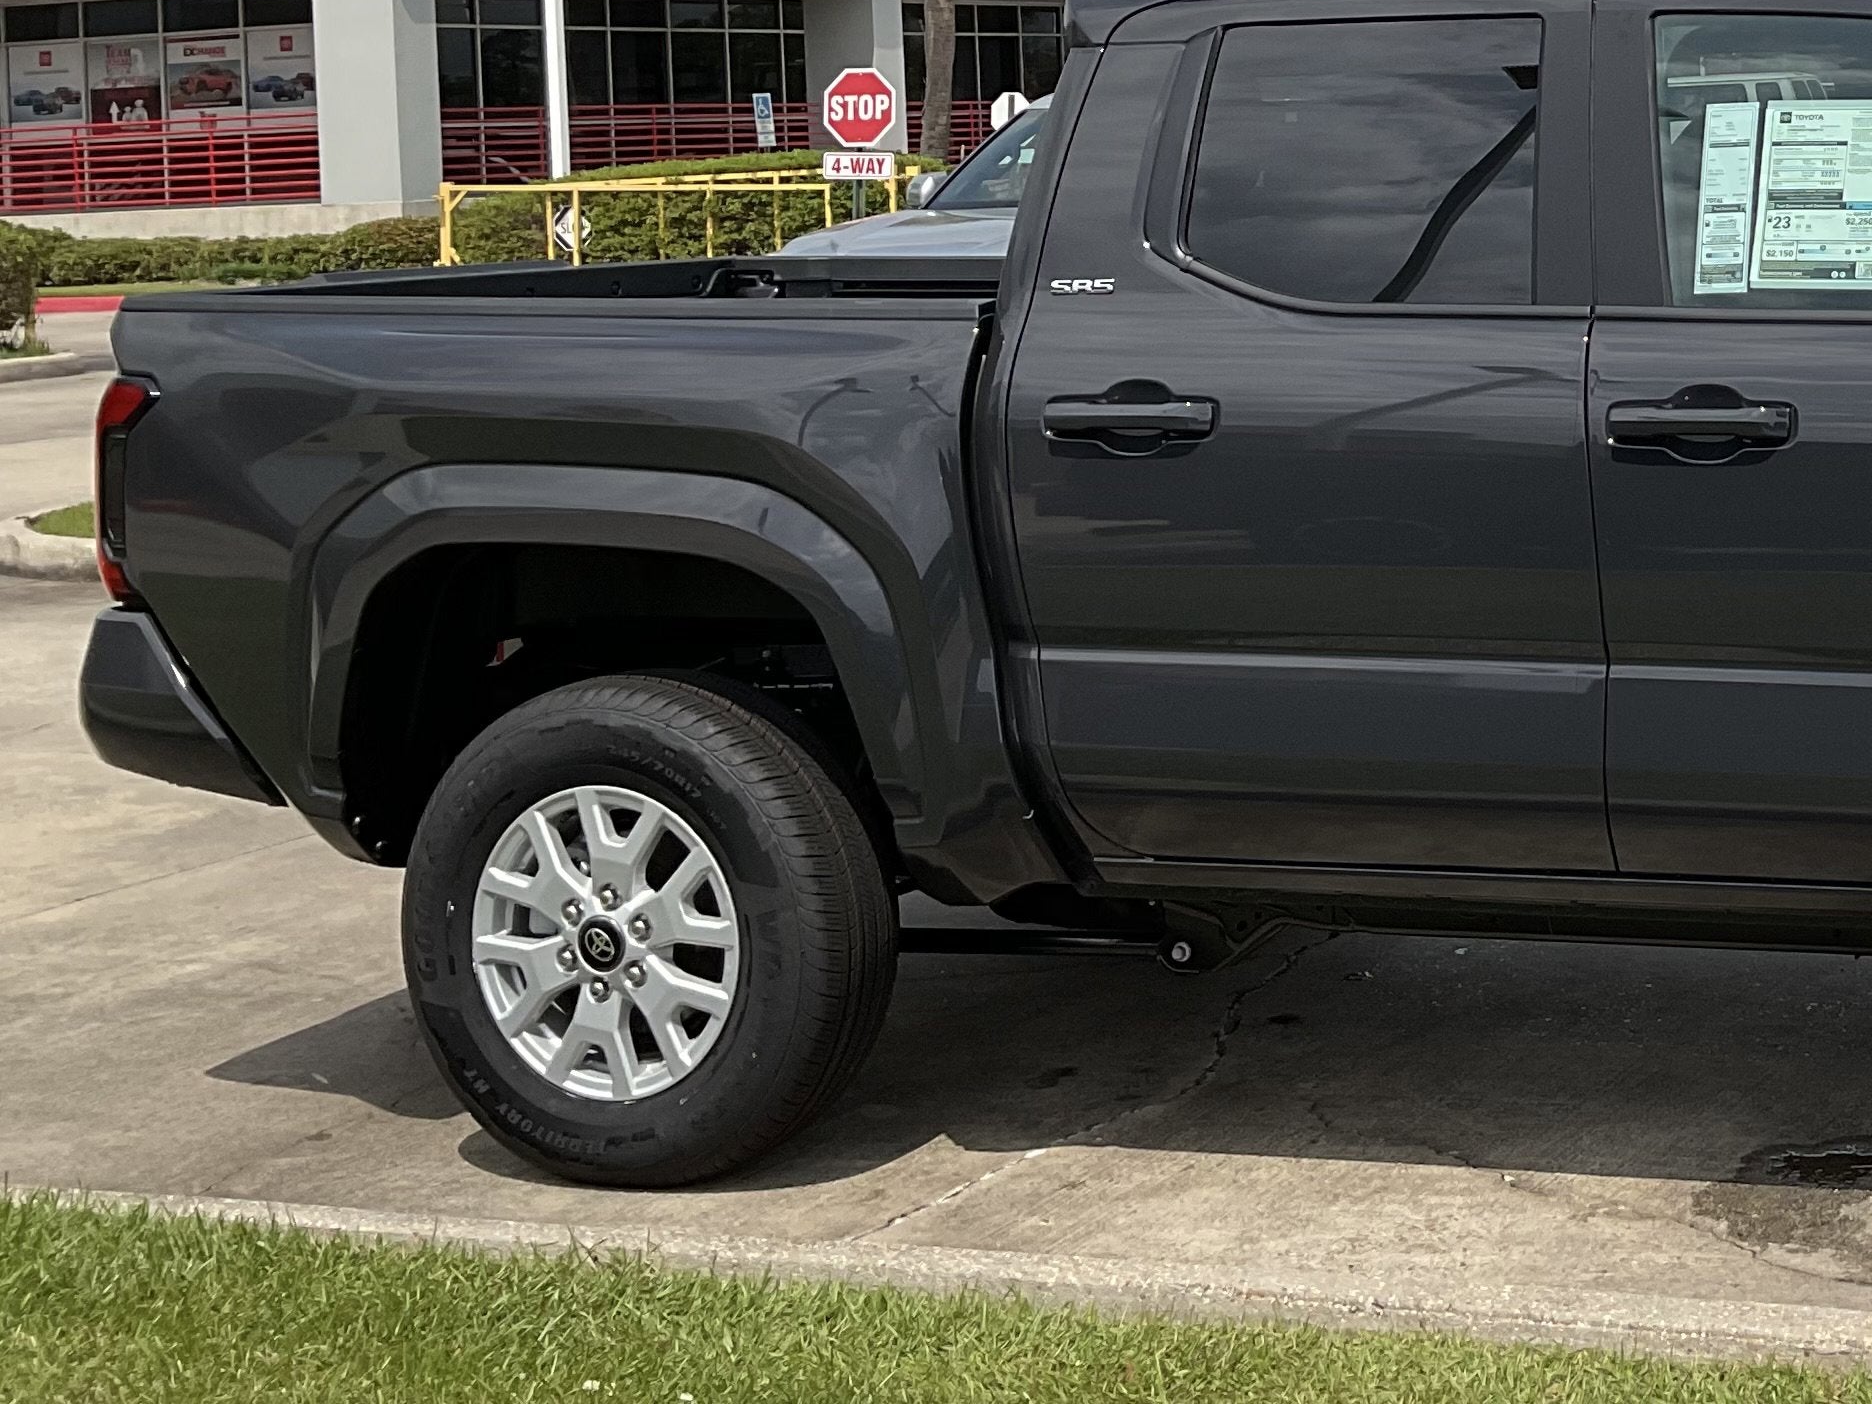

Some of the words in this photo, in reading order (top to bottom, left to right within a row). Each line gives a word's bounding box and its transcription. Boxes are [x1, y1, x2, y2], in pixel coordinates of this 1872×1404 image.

[830, 94, 890, 121] STOP
[831, 157, 885, 175] 4-WAY
[1773, 216, 1791, 229] 23
[1846, 218, 1872, 226] $2,250
[1051, 278, 1115, 294] SR5
